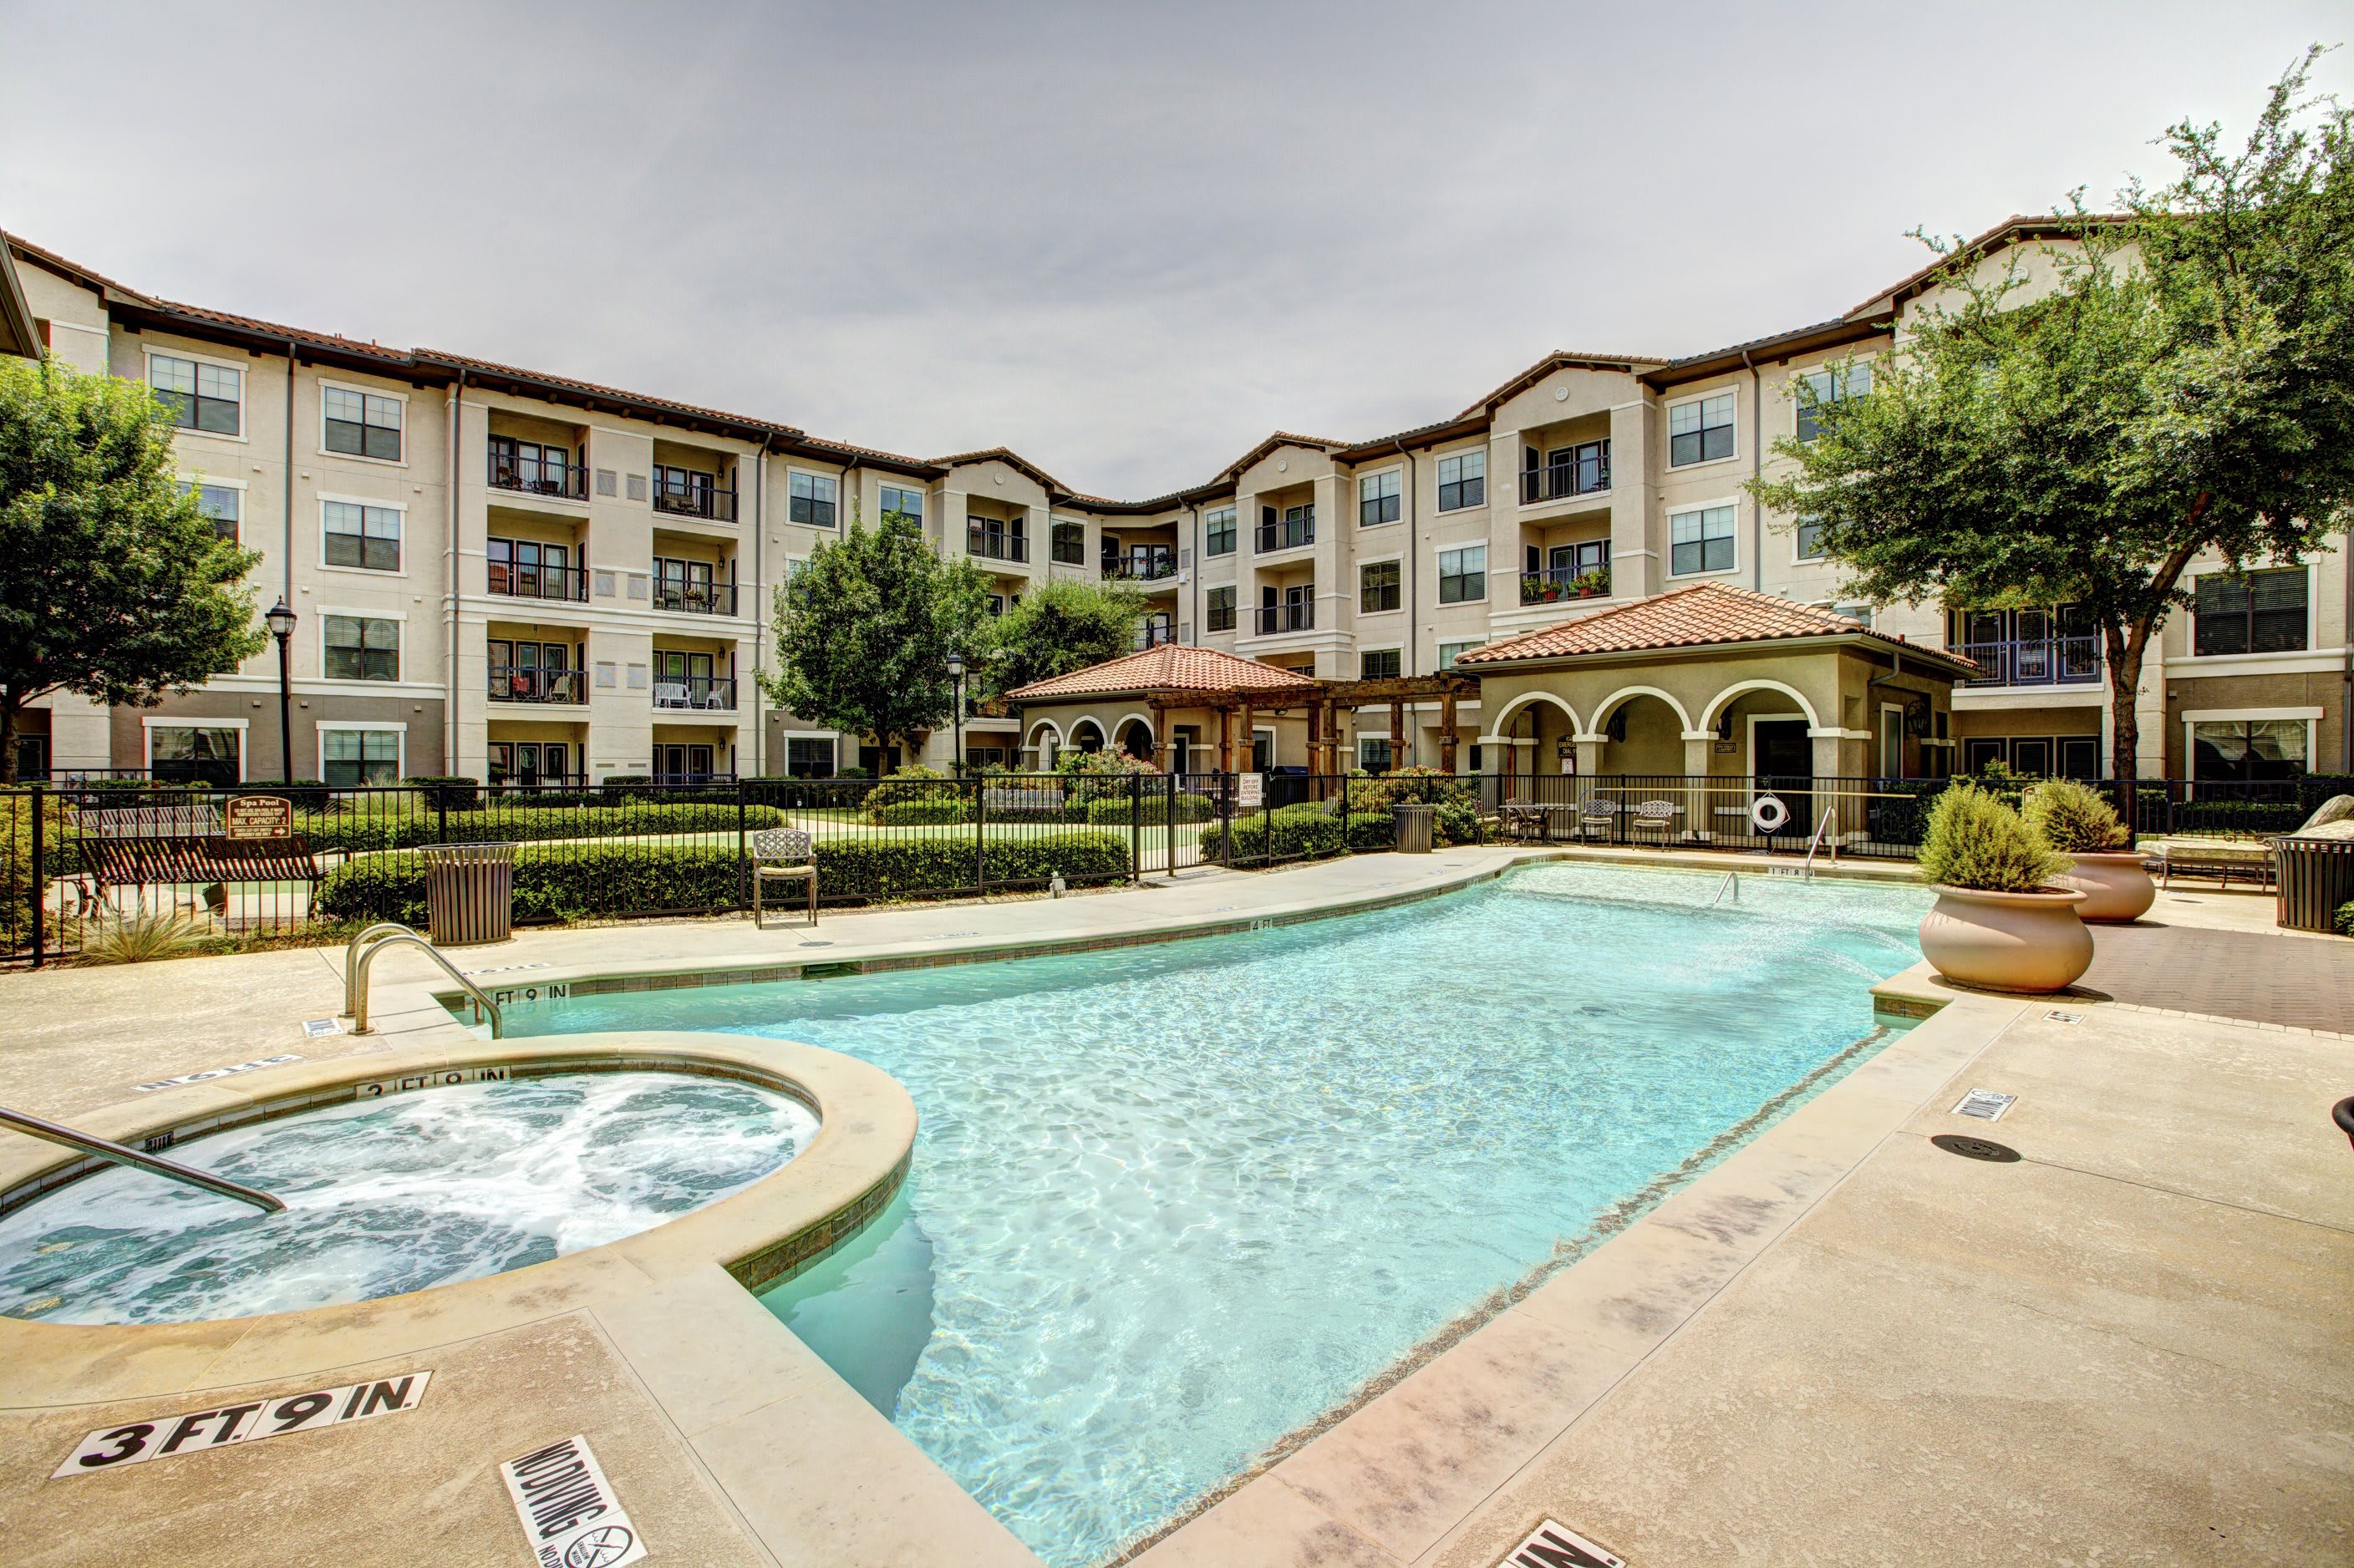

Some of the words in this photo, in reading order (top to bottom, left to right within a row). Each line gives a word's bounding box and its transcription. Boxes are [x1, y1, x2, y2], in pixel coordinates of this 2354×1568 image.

[240, 799, 257, 808] Spa
[231, 817, 248, 825] MAX.
[249, 816, 281, 825] CAPACITY:
[282, 816, 287, 825] 2
[1252, 920, 1258, 930] 4
[496, 990, 515, 1006] FT
[525, 988, 537, 1002] 9
[549, 984, 566, 999] IN
[480, 1068, 504, 1081] IN
[79, 1424, 155, 1467] 3
[158, 1404, 263, 1454] FT.
[270, 1393, 333, 1434] 9
[340, 1376, 415, 1420] IN.
[511, 1439, 579, 1477] NO
[520, 1459, 608, 1540] DIVING
[537, 1544, 558, 1560] NO
[571, 1550, 583, 1565] WATER
[577, 1540, 591, 1560] SHALLOW
